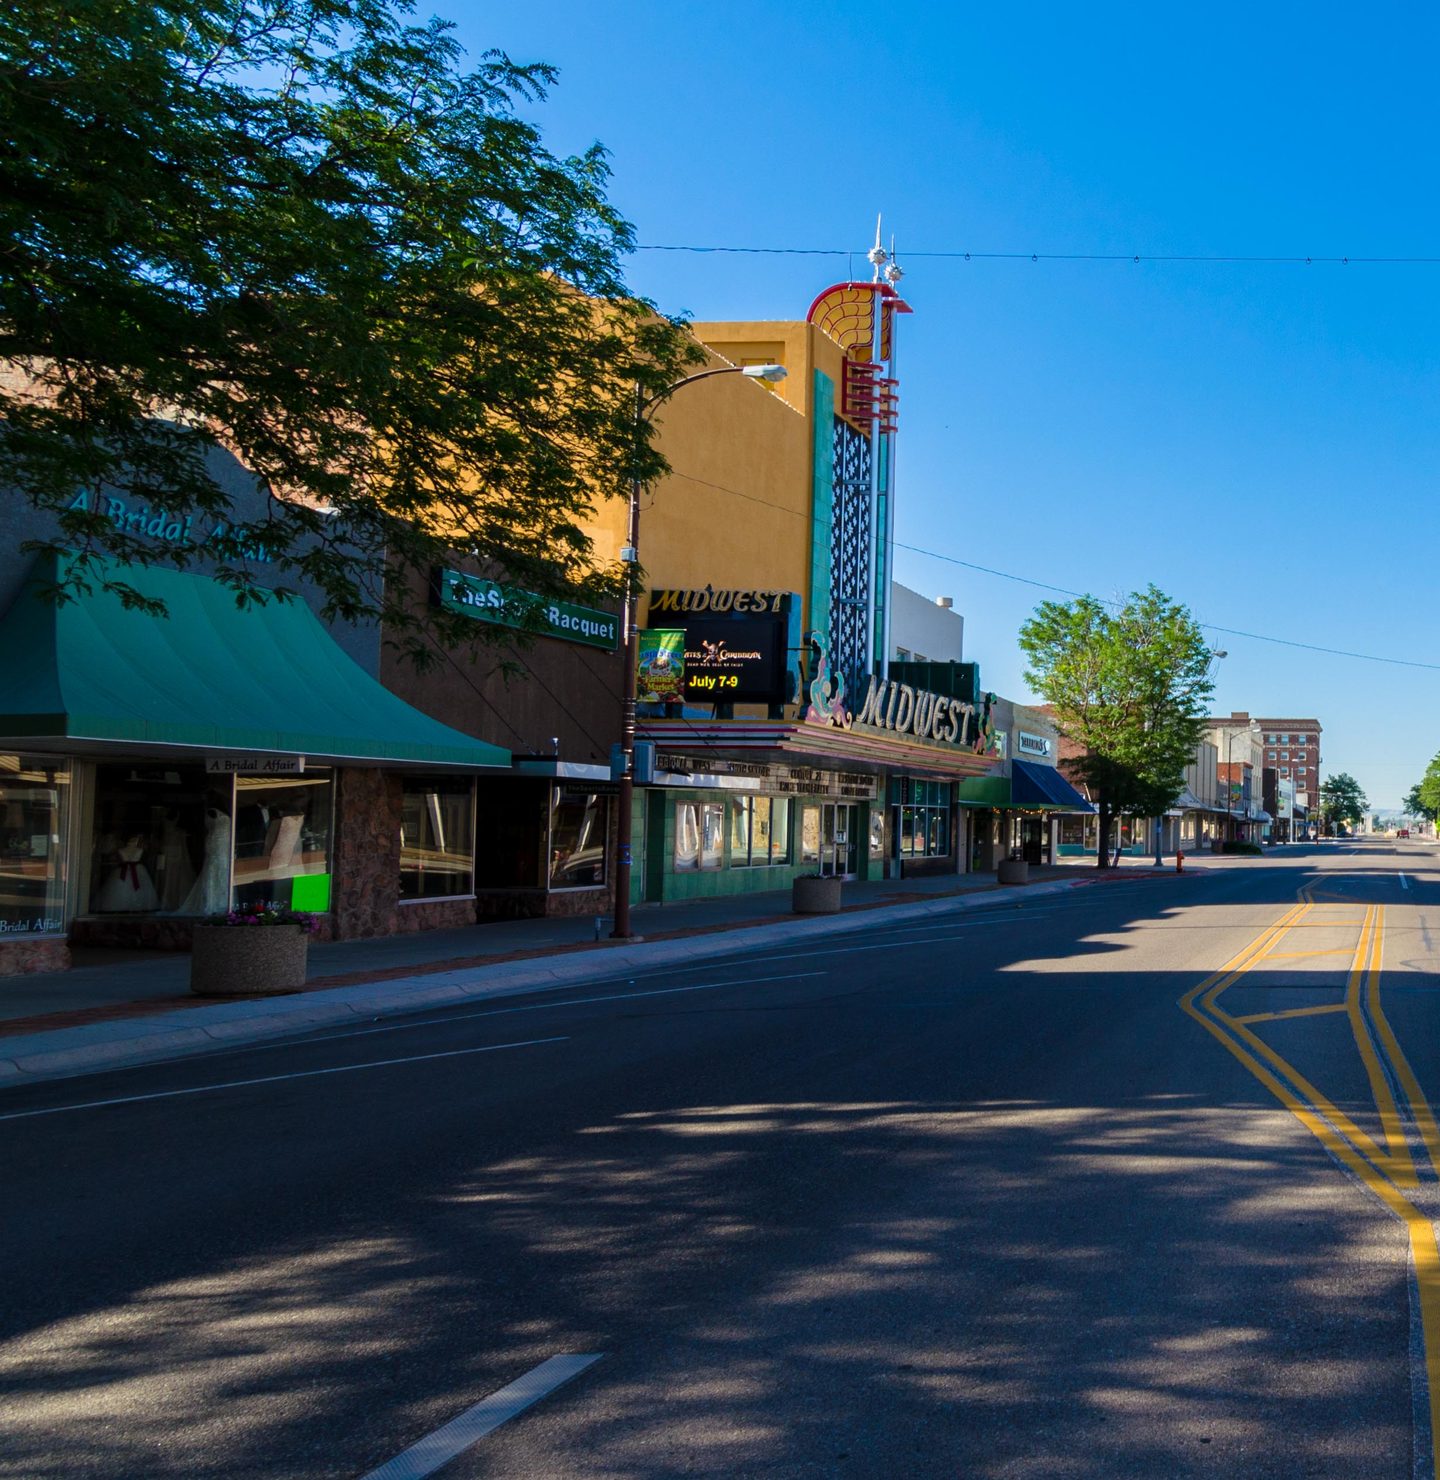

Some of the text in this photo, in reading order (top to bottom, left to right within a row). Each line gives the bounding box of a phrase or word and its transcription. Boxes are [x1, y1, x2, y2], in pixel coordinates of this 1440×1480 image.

[69, 488, 88, 511] A
[107, 496, 192, 545] Bridal
[649, 590, 789, 614] MIDWEST
[689, 675, 738, 690] July 7-9
[856, 675, 976, 746] MIDWEST
[210, 759, 296, 772] A Bridal Affair
[0, 919, 62, 933] Bridal Affair
